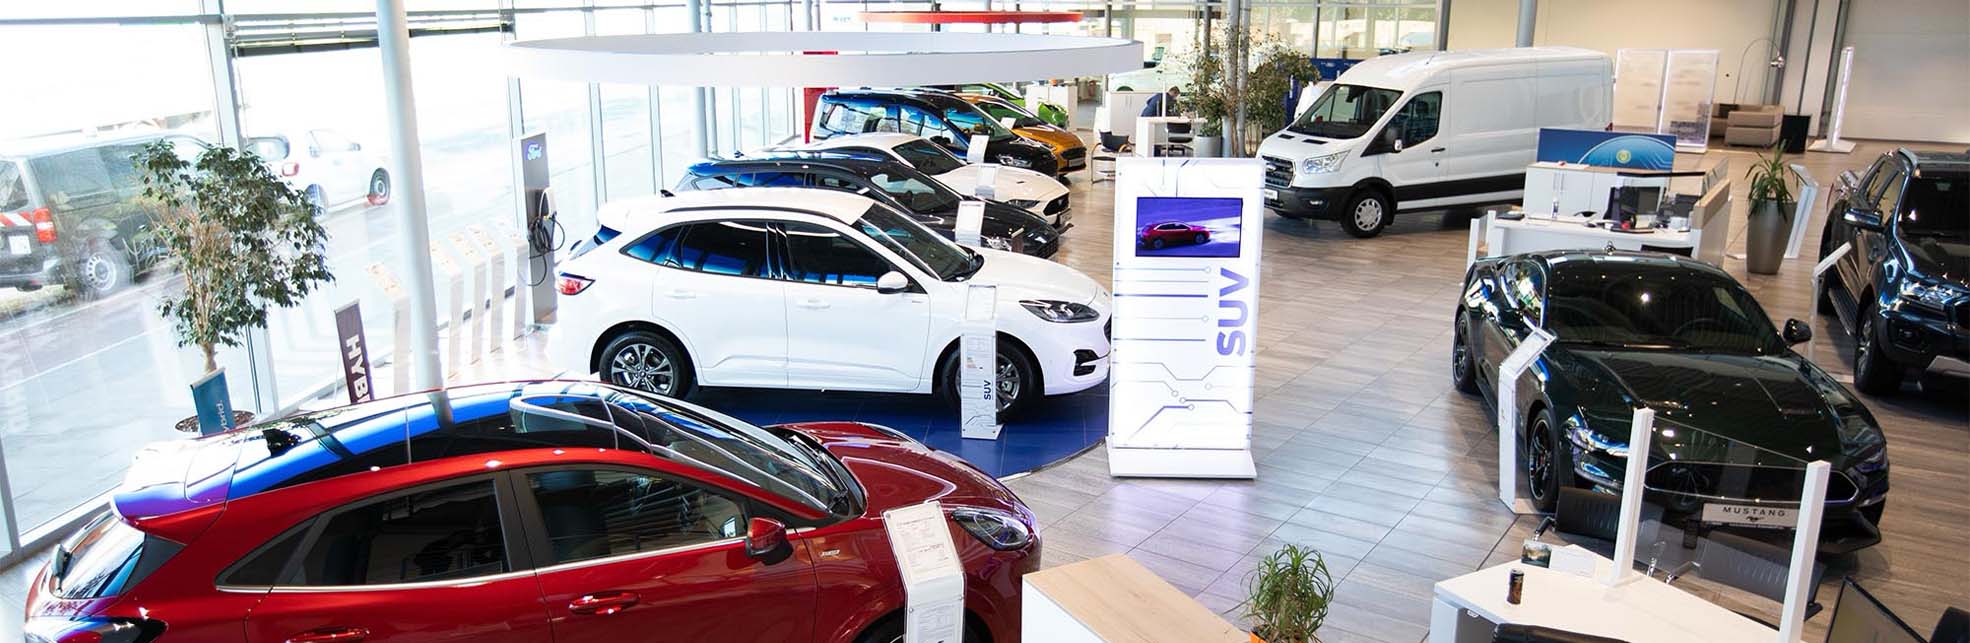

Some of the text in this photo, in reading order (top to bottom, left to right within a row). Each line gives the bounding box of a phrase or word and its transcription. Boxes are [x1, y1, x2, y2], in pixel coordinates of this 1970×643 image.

[1217, 267, 1249, 356] SUV
[983, 380, 992, 400] SUV
[1722, 506, 1785, 517] MUSTANG
